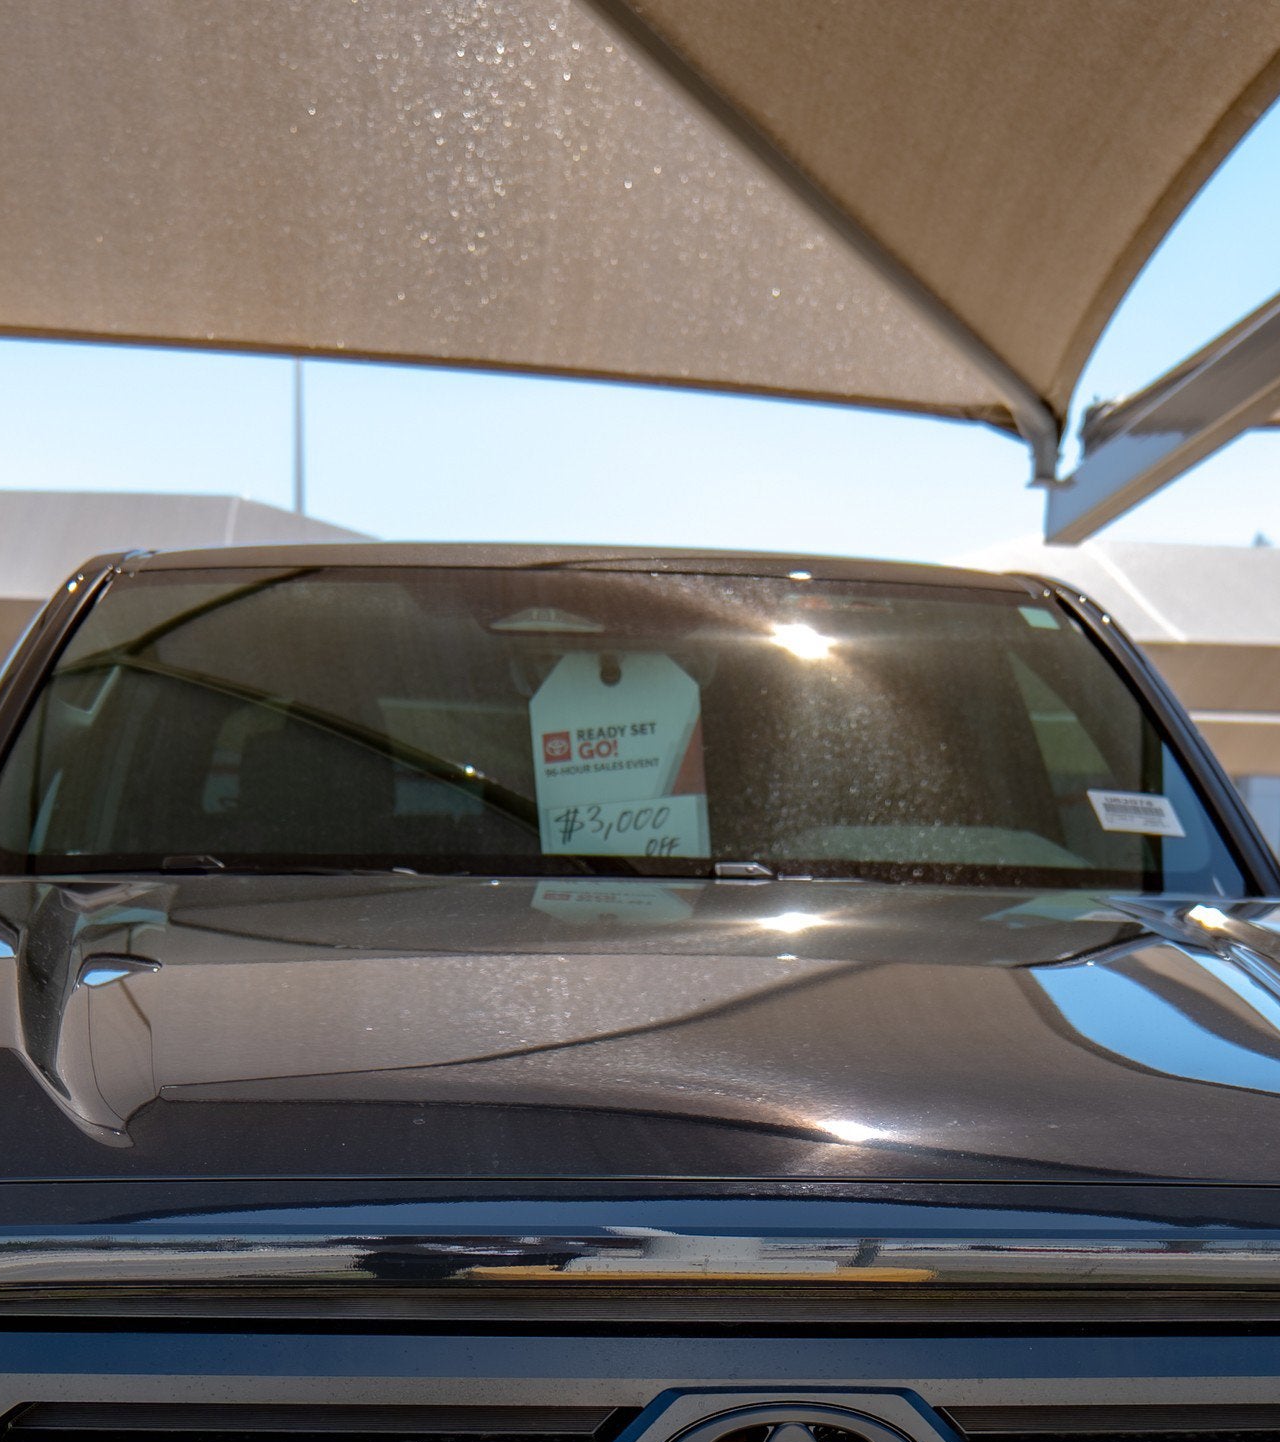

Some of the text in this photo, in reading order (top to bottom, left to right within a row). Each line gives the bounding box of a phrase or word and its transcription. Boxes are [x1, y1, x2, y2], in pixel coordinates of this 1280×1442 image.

[577, 722, 657, 741] READY SET
[578, 739, 619, 760] GO!
[593, 760, 624, 772] SALES
[626, 757, 660, 770] EVENT
[554, 805, 671, 846] $3,000
